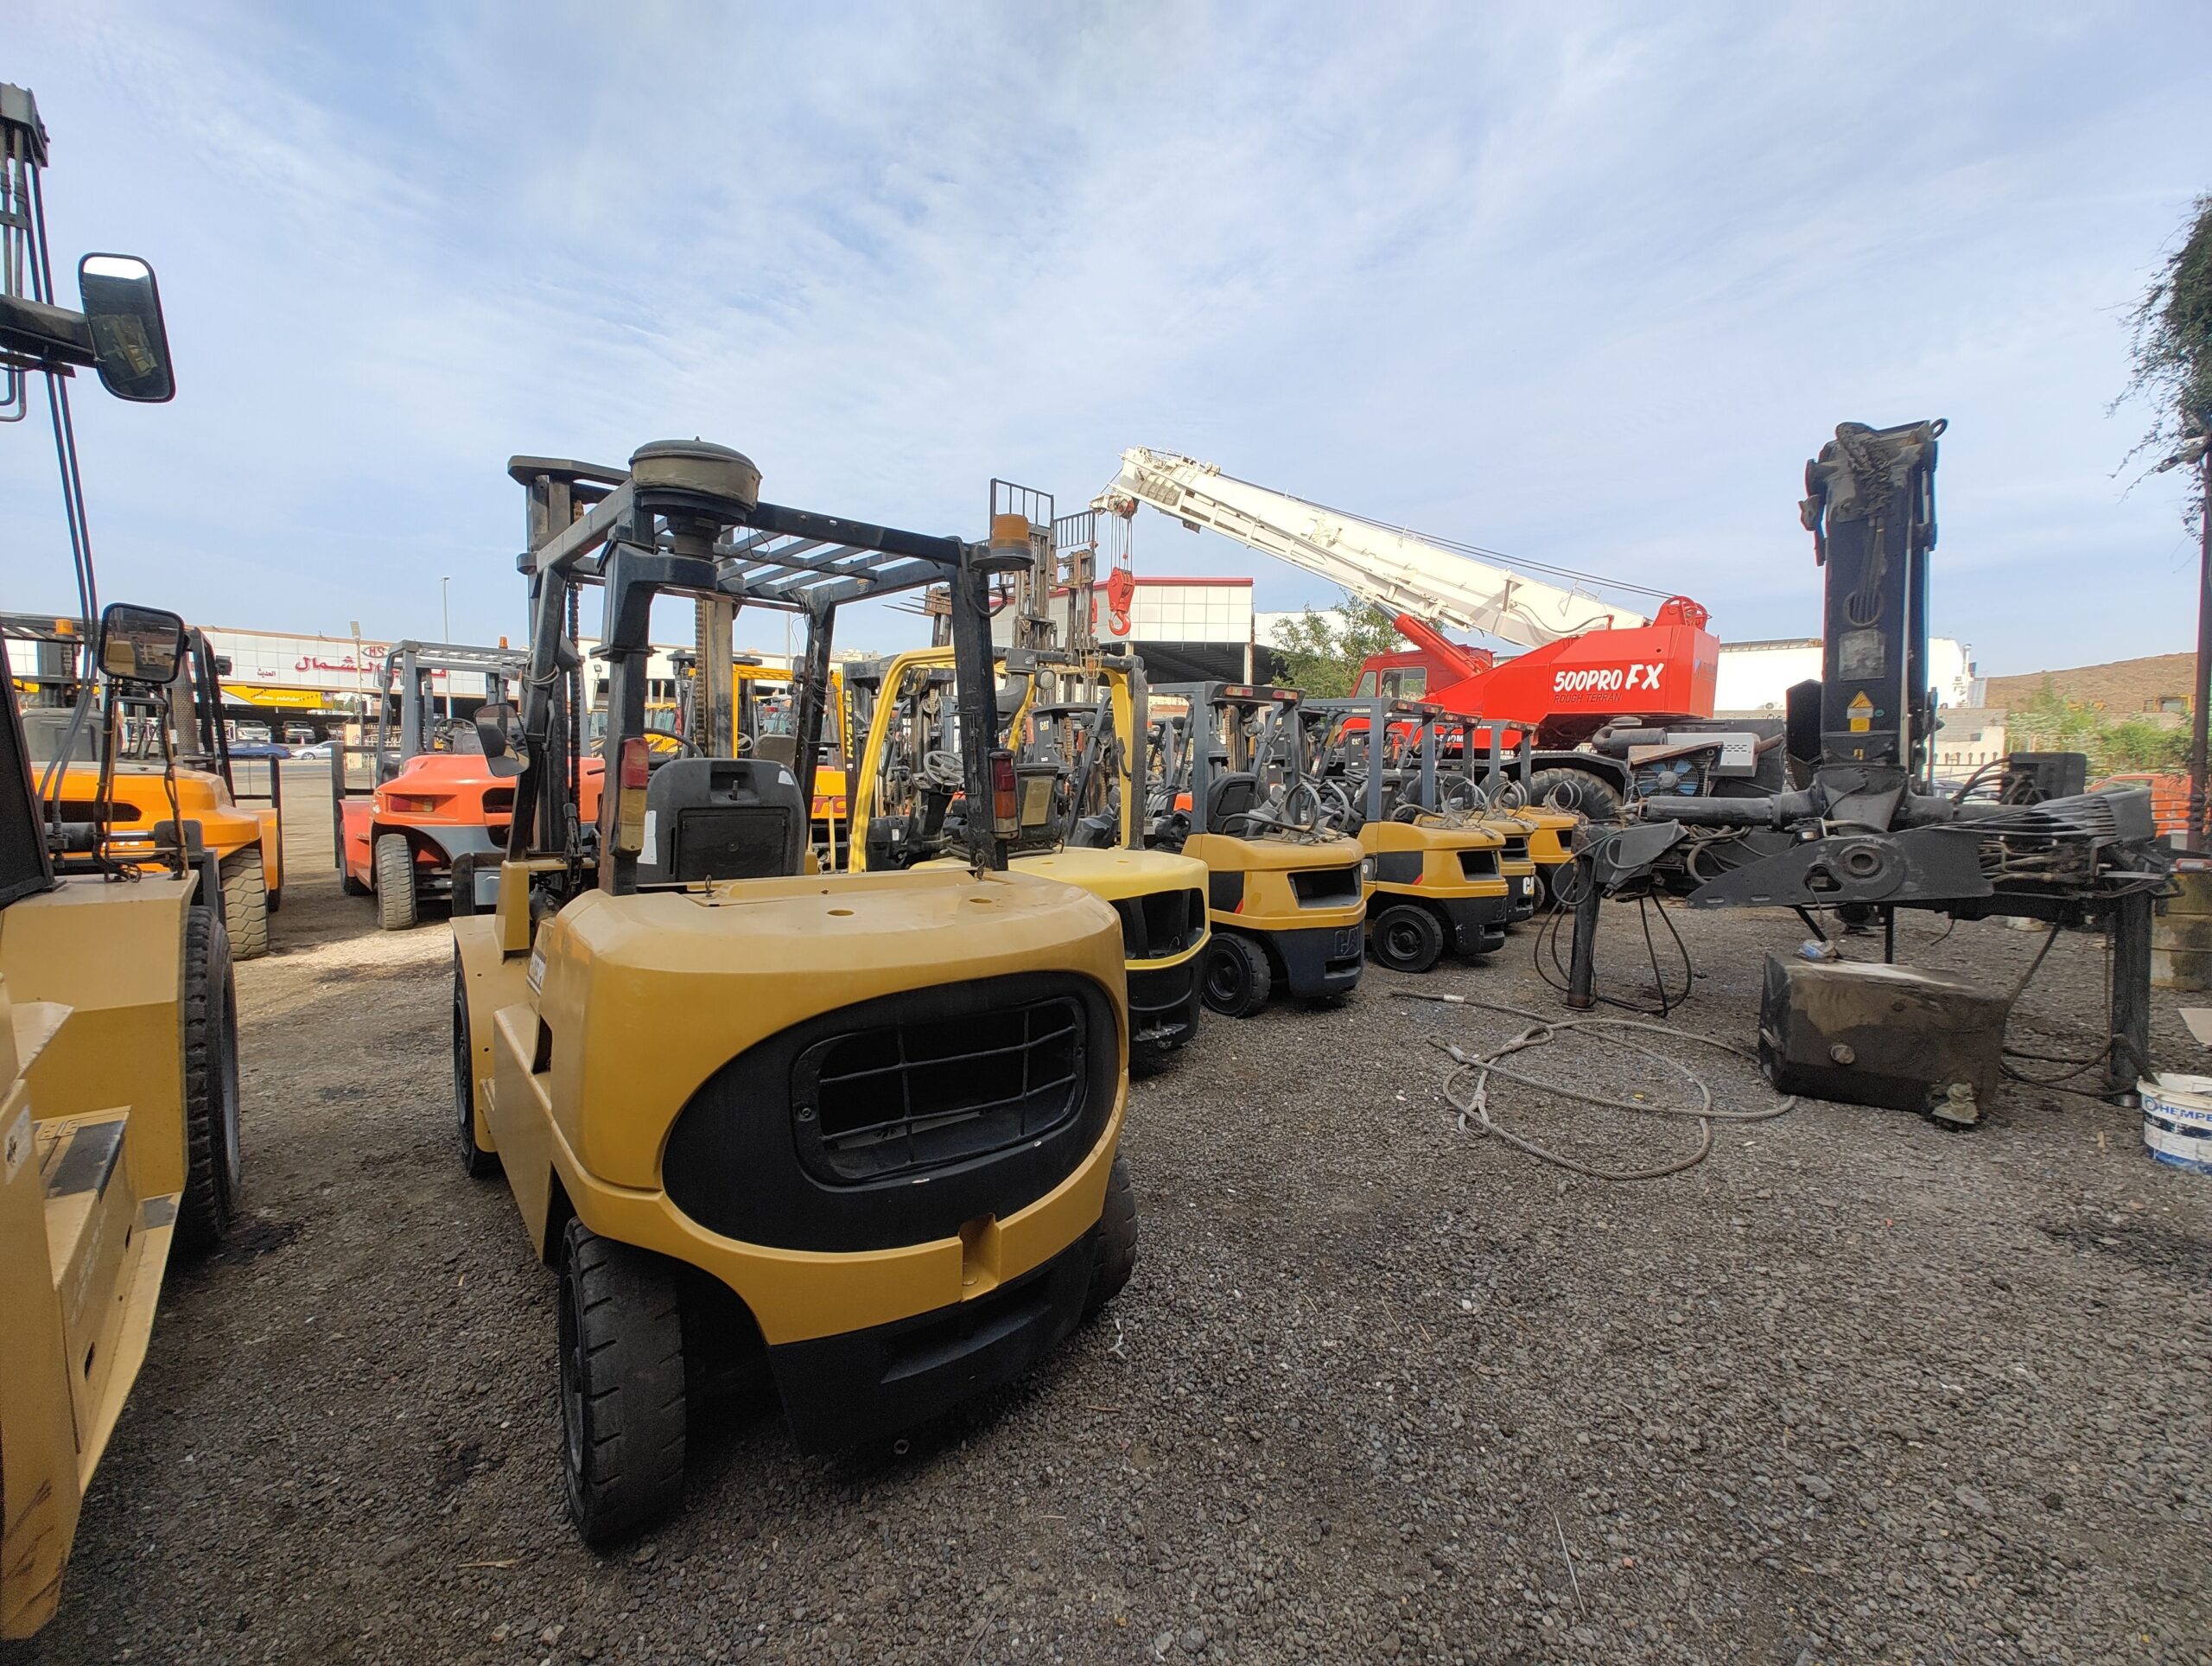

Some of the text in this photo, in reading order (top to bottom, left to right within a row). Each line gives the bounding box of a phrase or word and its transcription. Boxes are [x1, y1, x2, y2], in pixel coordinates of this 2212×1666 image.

[1553, 662, 1665, 692] 500PRO FX
[1554, 694, 1583, 704] ROUGH
[1039, 720, 1049, 731] CAT
[2160, 1105, 2212, 1122] HEMPE
